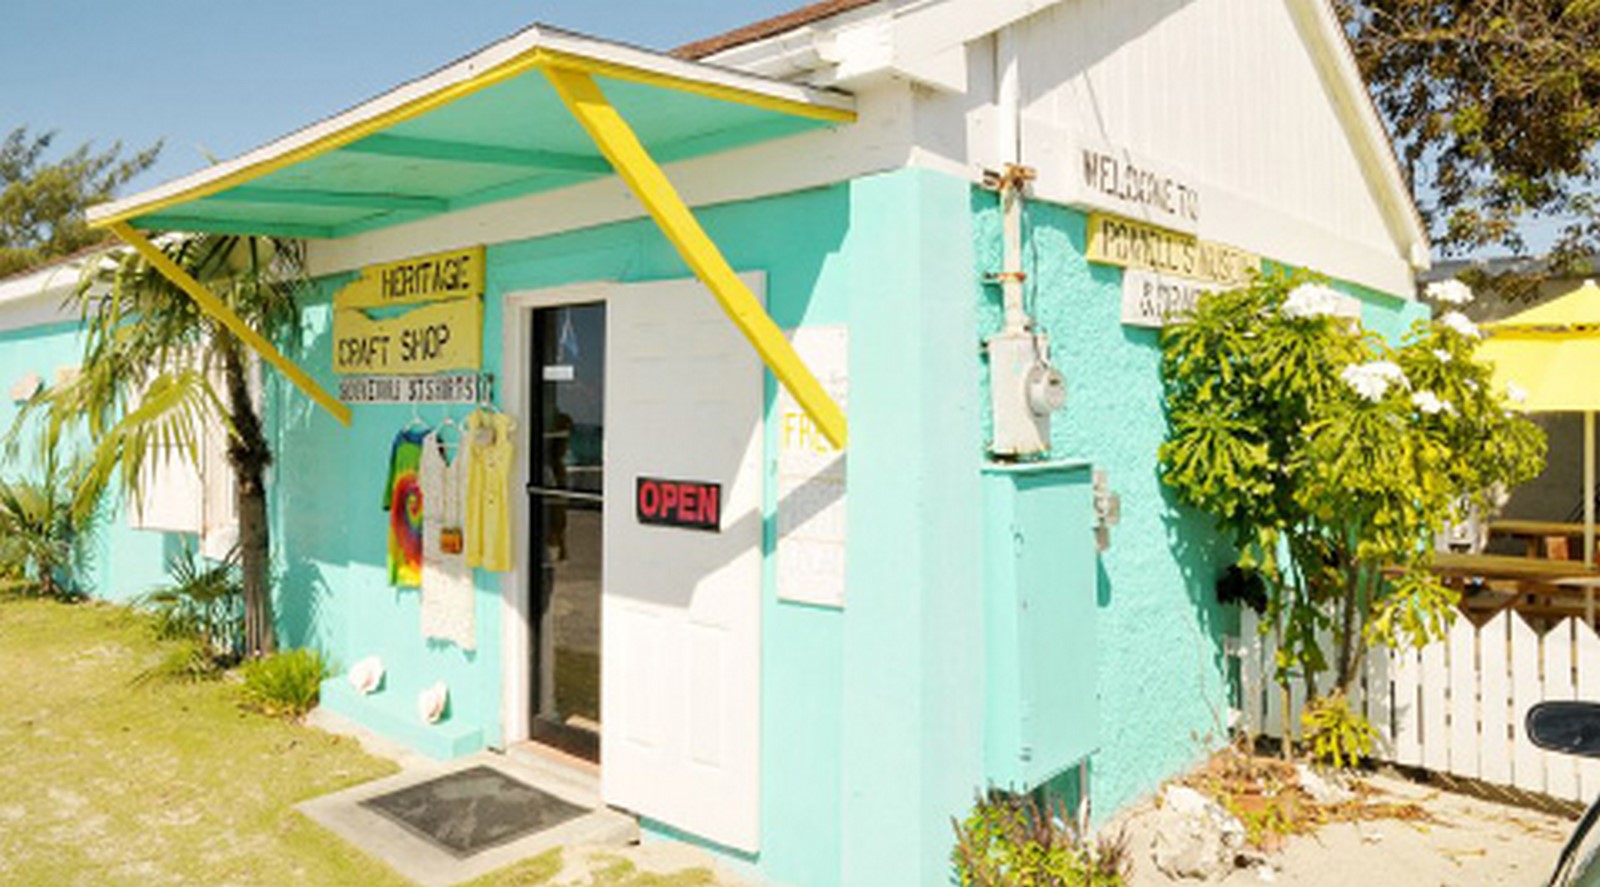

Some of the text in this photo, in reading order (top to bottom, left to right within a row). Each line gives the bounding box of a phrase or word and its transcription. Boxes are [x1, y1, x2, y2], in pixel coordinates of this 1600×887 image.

[1082, 149, 1199, 223] WELCOME TO
[381, 255, 470, 298] HERITAGE
[337, 323, 450, 367] CRAFT SHOP
[639, 481, 718, 523] OPEN
